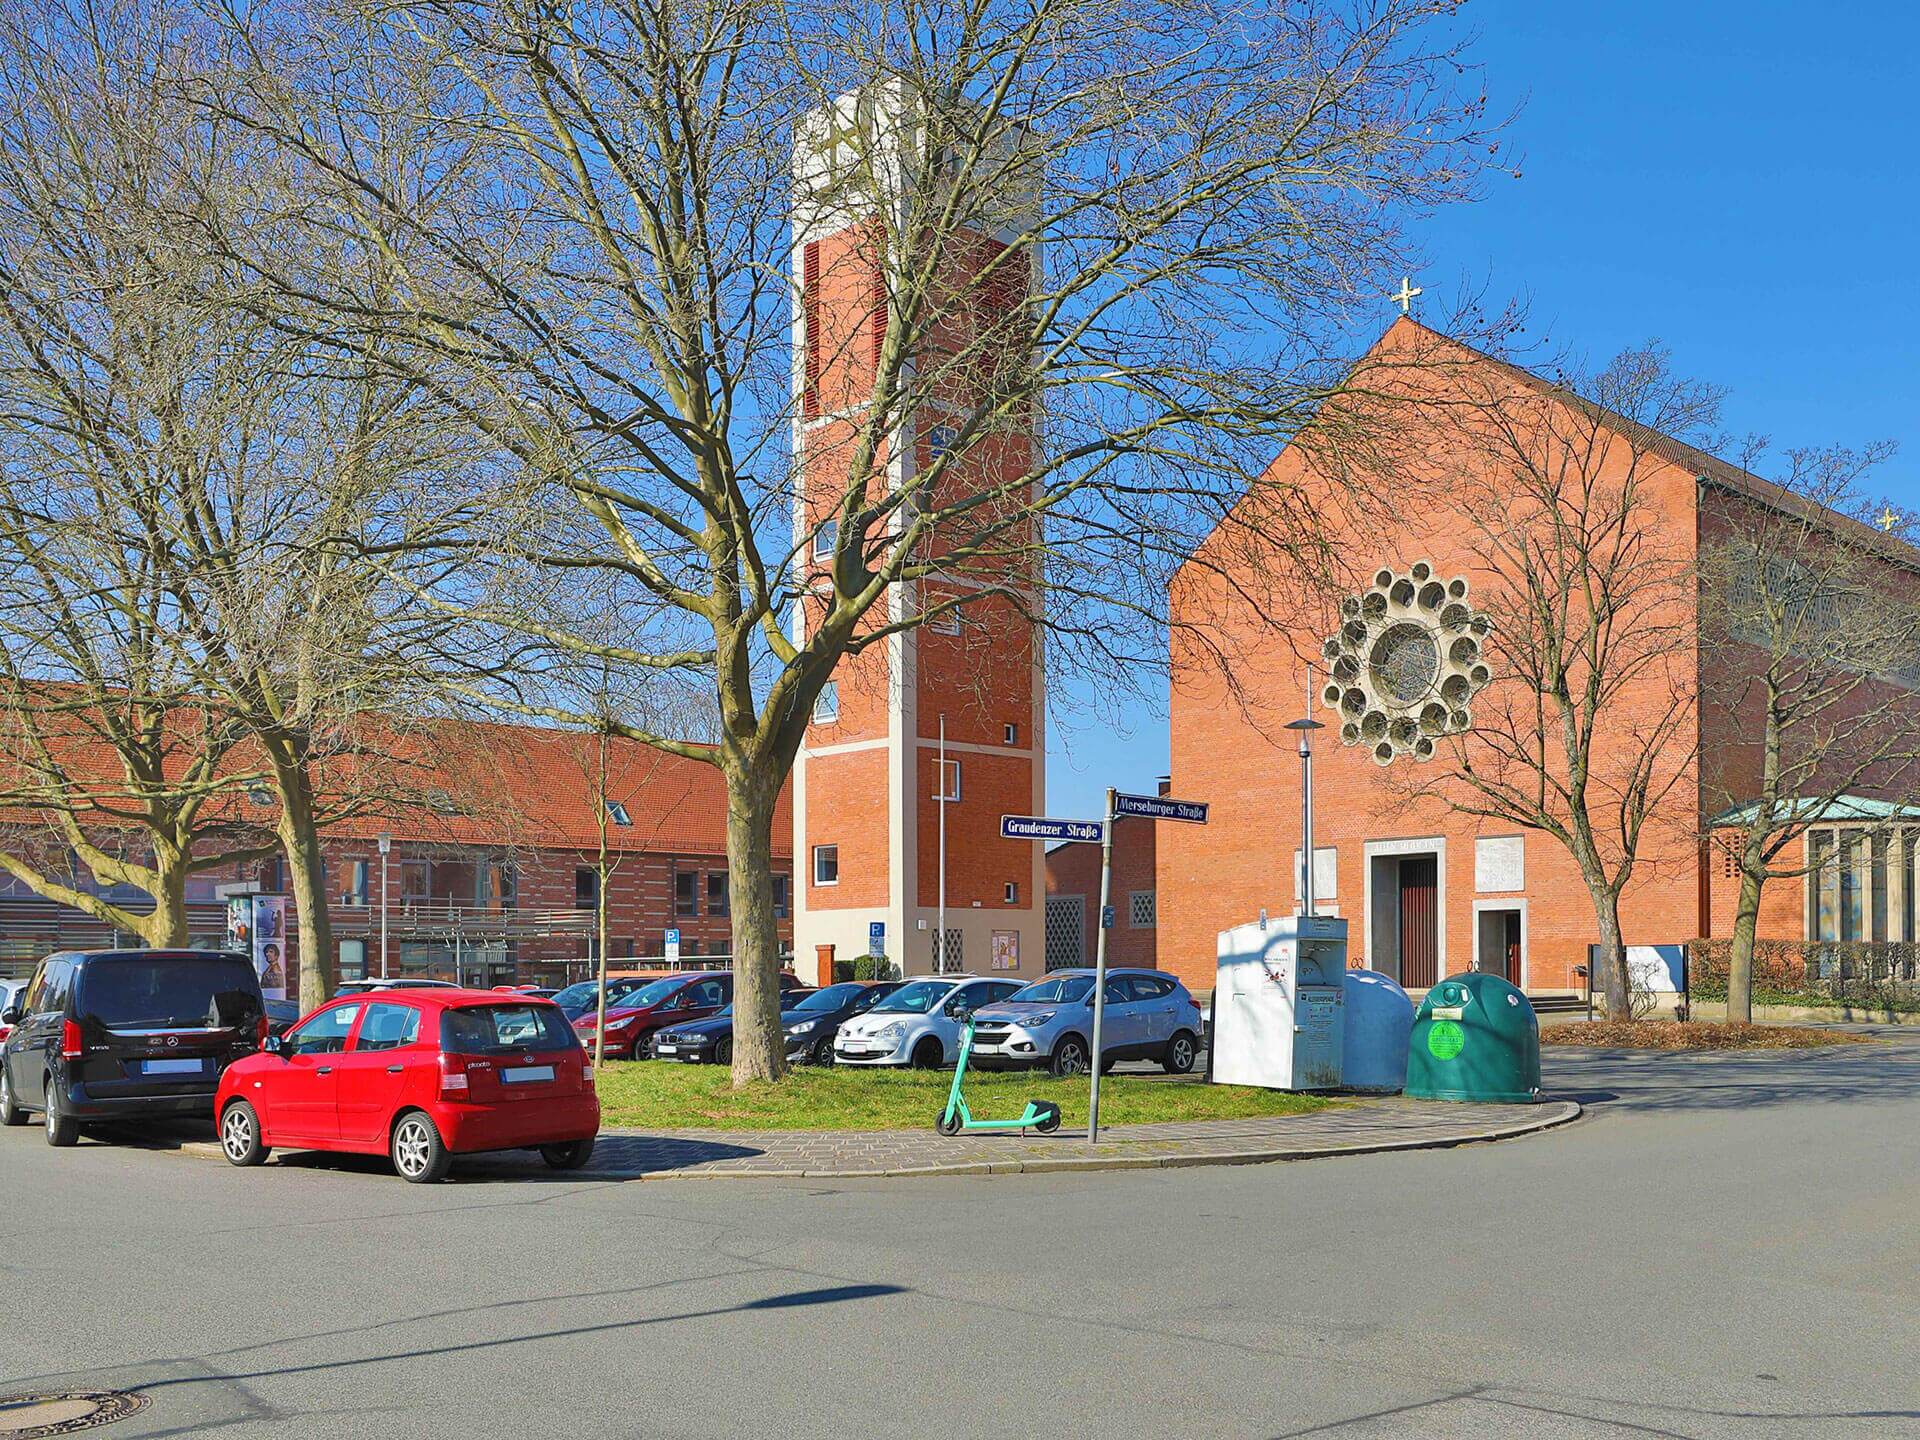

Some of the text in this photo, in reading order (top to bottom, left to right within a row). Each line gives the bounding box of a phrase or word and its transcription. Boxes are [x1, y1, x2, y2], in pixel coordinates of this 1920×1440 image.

[1119, 798, 1204, 818] Merseburger Straße
[1008, 820, 1098, 839] Graudenzer Straße
